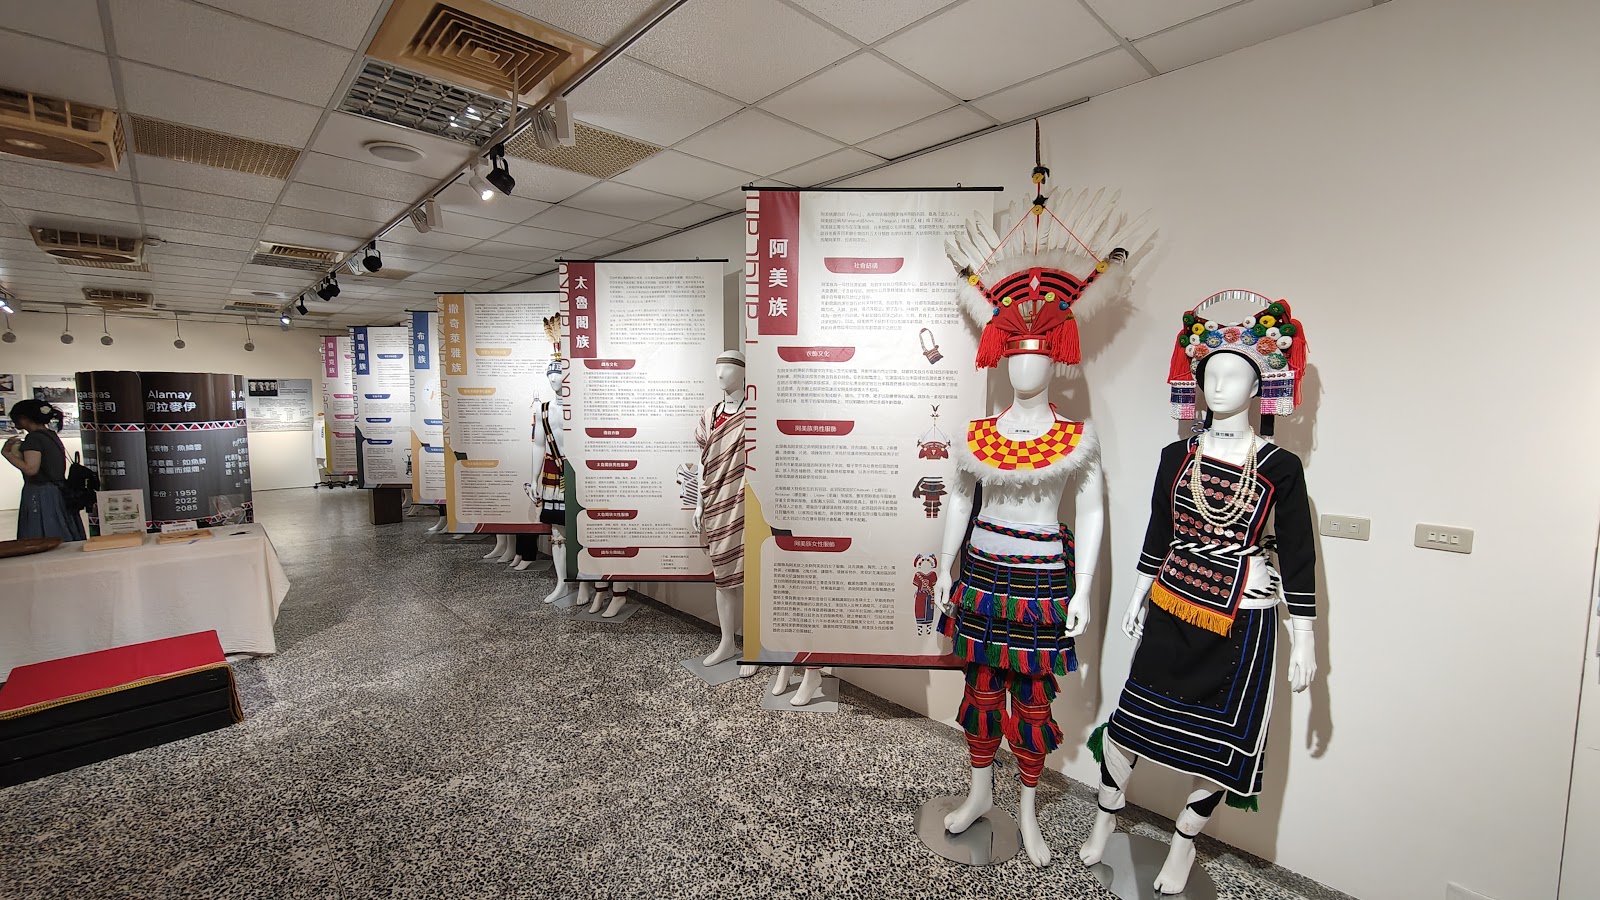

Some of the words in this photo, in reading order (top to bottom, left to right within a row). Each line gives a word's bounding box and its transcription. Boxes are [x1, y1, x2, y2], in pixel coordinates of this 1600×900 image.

[767, 237, 789, 318] 阿美族
[574, 275, 590, 349] 太魯閣族
[447, 303, 463, 373] 撒奇萊雅族
[416, 331, 427, 364] 布農族
[147, 389, 192, 400] Alamay
[146, 401, 197, 413] 阿拉麥伊
[174, 497, 198, 505] 2022
[175, 504, 198, 512] 2085
[793, 540, 836, 548] 阿美族女性服飾
